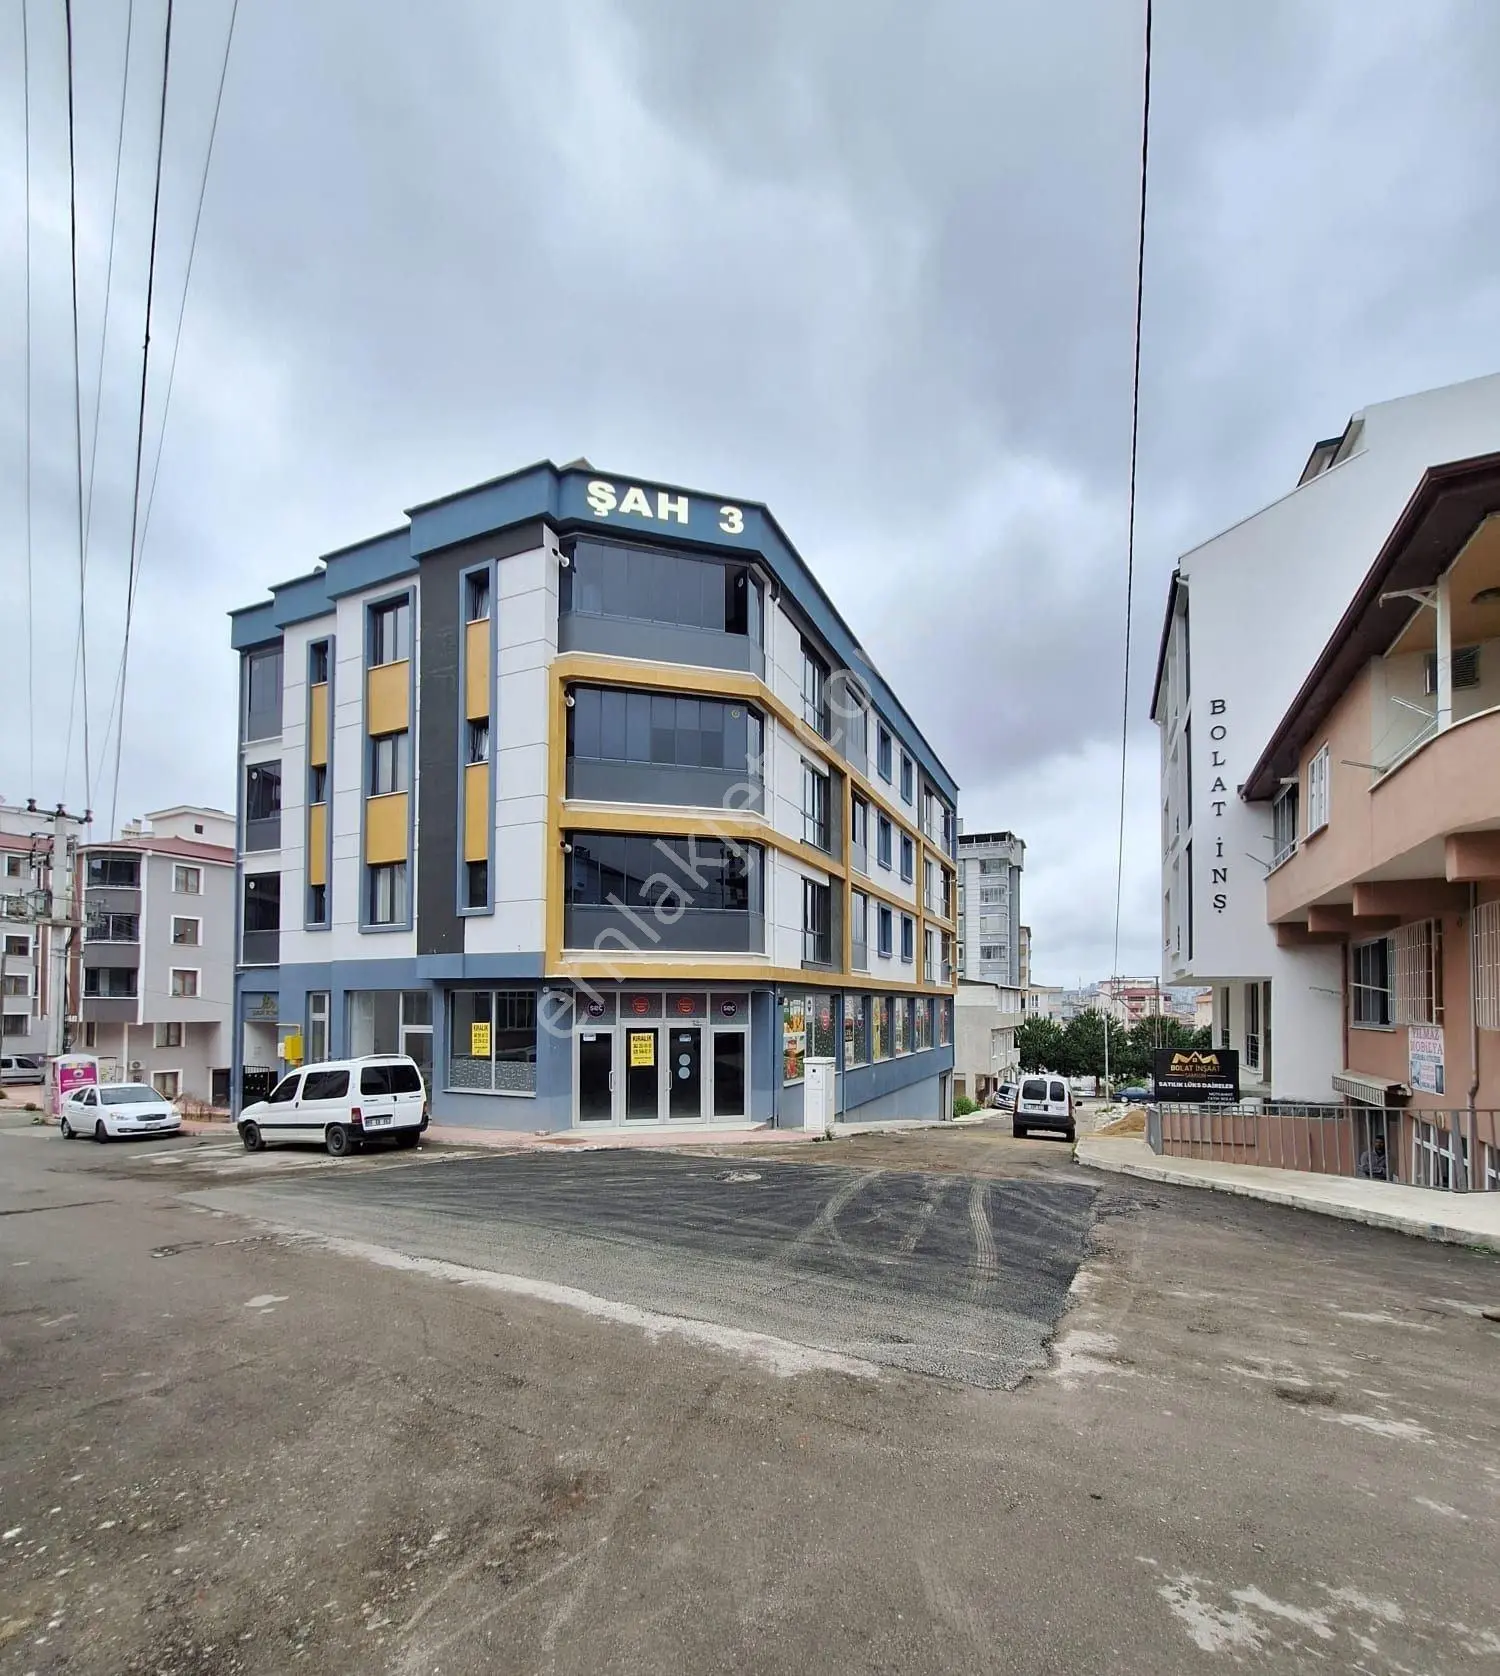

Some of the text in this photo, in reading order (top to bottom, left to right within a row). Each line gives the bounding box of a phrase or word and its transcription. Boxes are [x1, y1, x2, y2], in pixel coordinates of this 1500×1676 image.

[586, 480, 745, 535] ŞAH 3
[1210, 699, 1228, 914] BOLAT İNŞ
[1170, 1064, 1194, 1072] BOLAT
